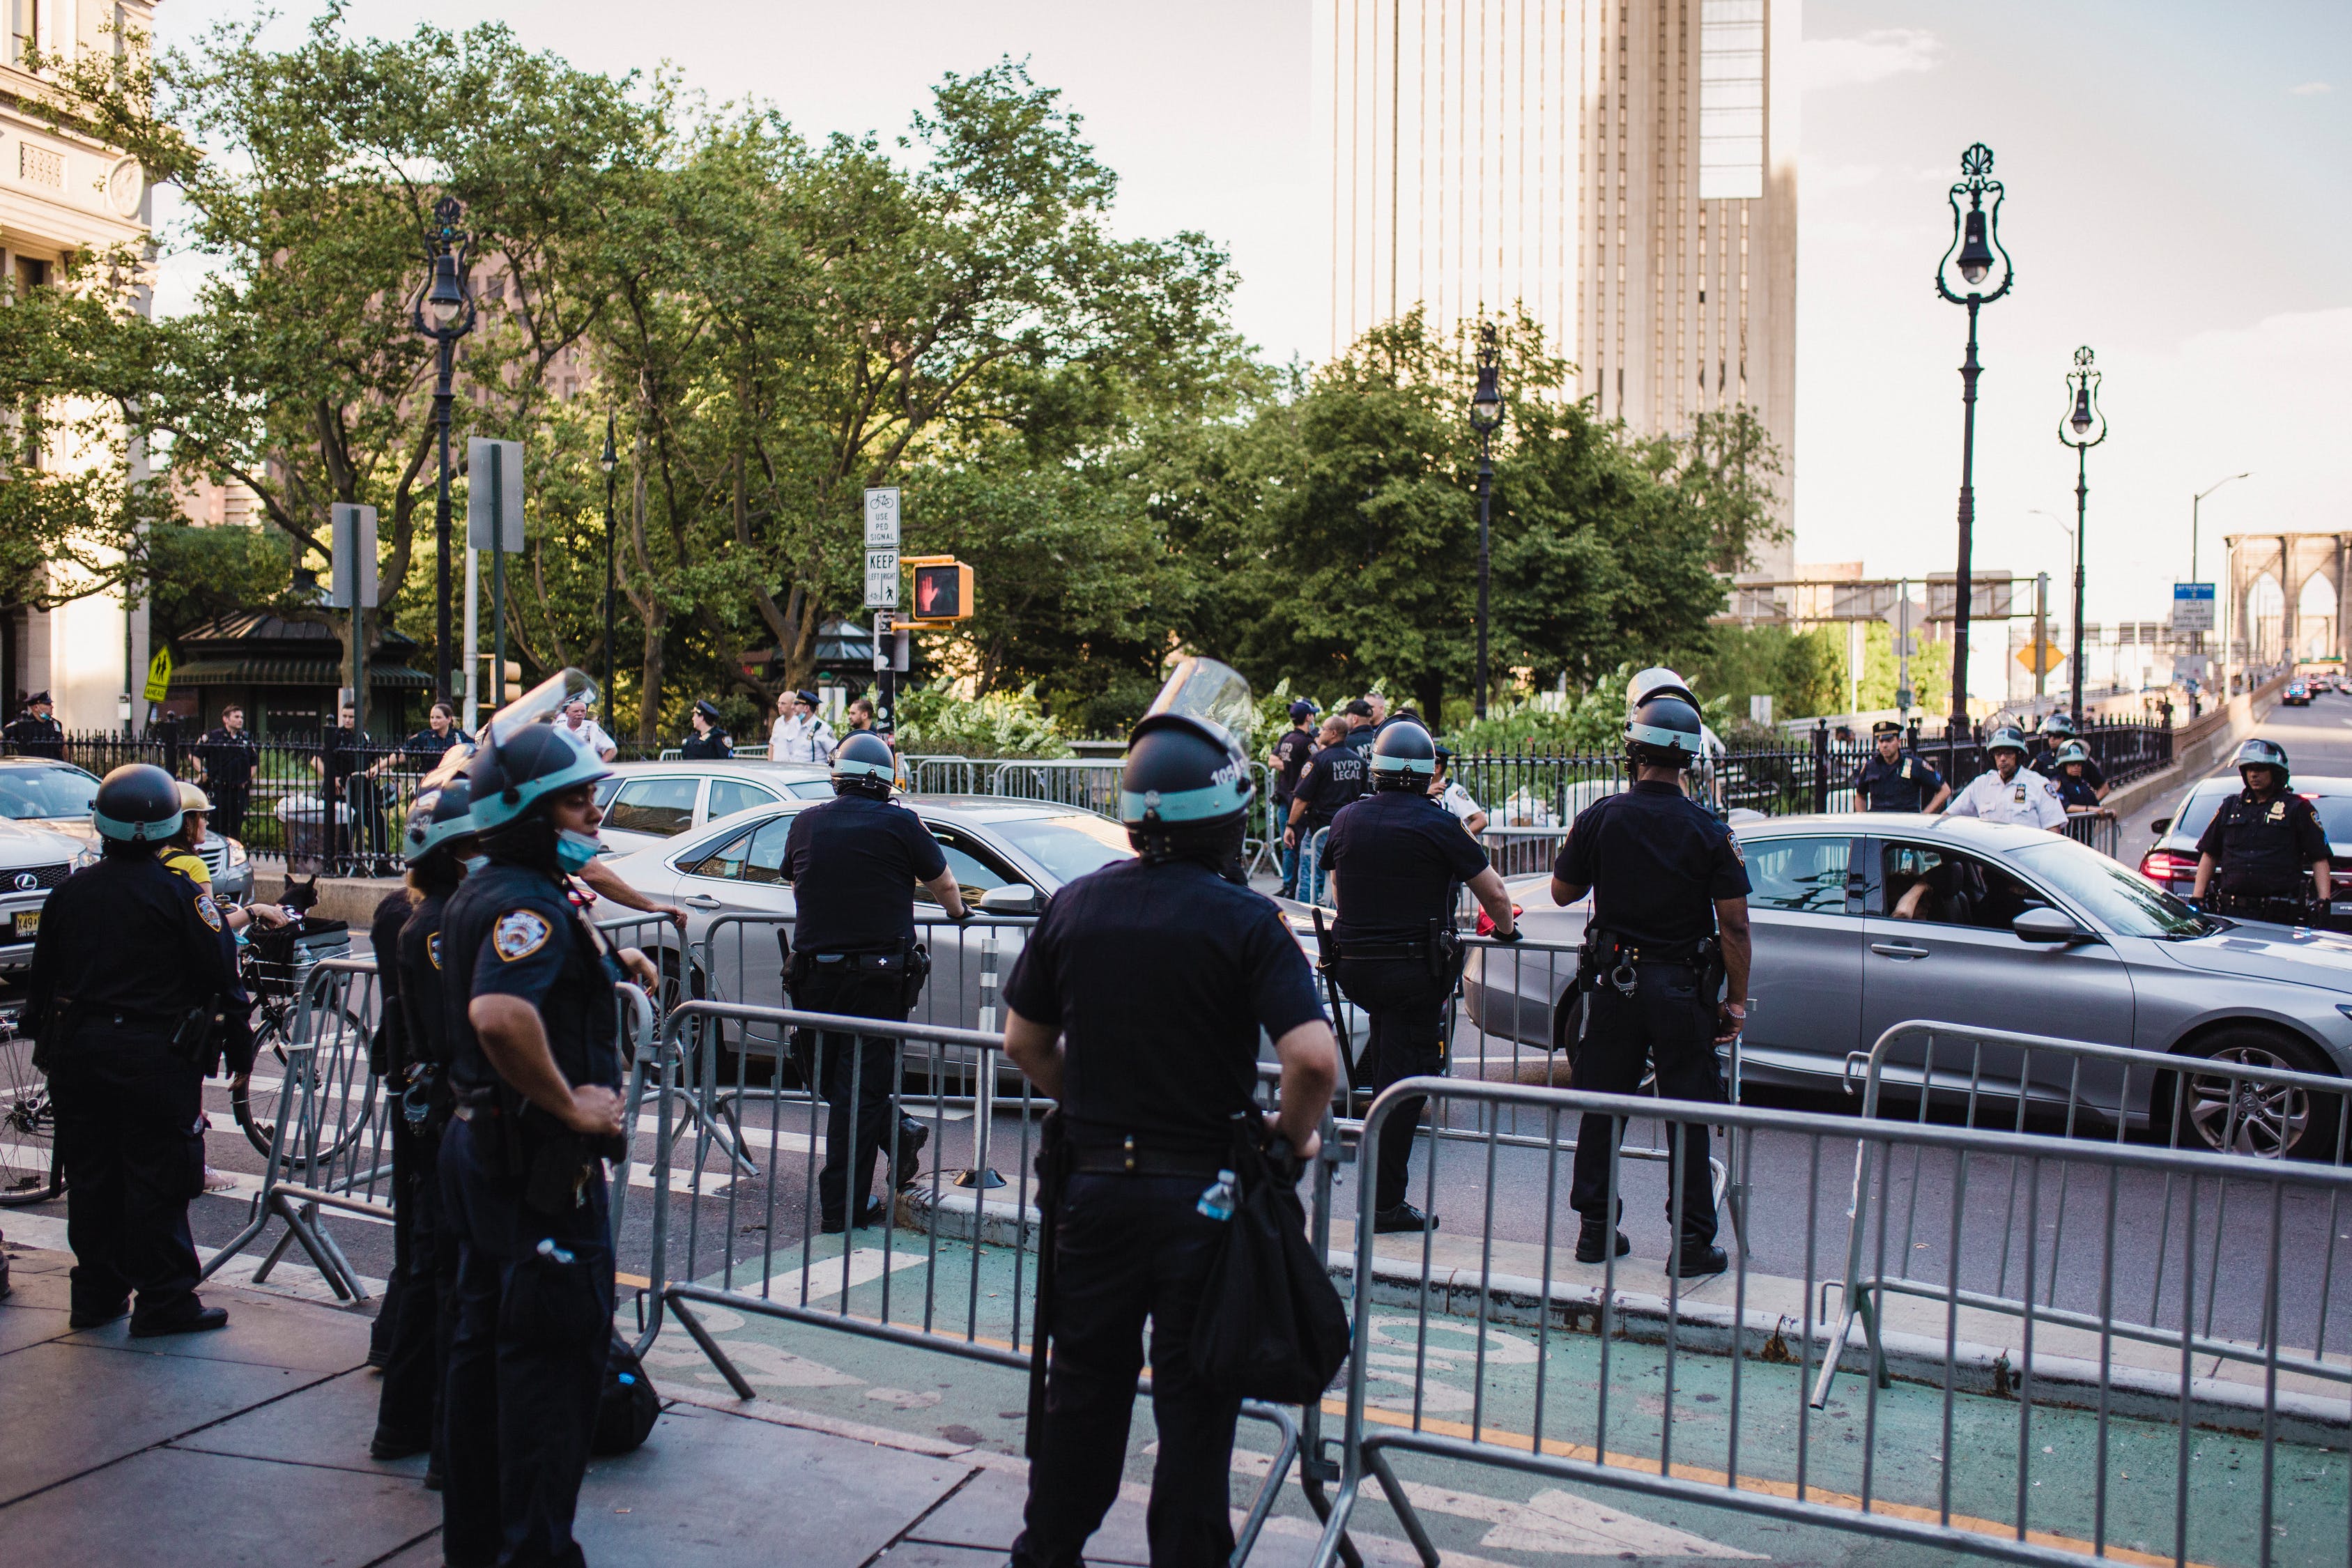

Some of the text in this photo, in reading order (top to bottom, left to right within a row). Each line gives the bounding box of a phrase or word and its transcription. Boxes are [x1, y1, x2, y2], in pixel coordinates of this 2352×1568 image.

[870, 555, 894, 569] KEEP
[882, 572, 896, 581] RIGHT
[146, 687, 164, 698] AHEAD
[1332, 760, 1361, 771] NYPD
[1333, 769, 1361, 781] LEGAL
